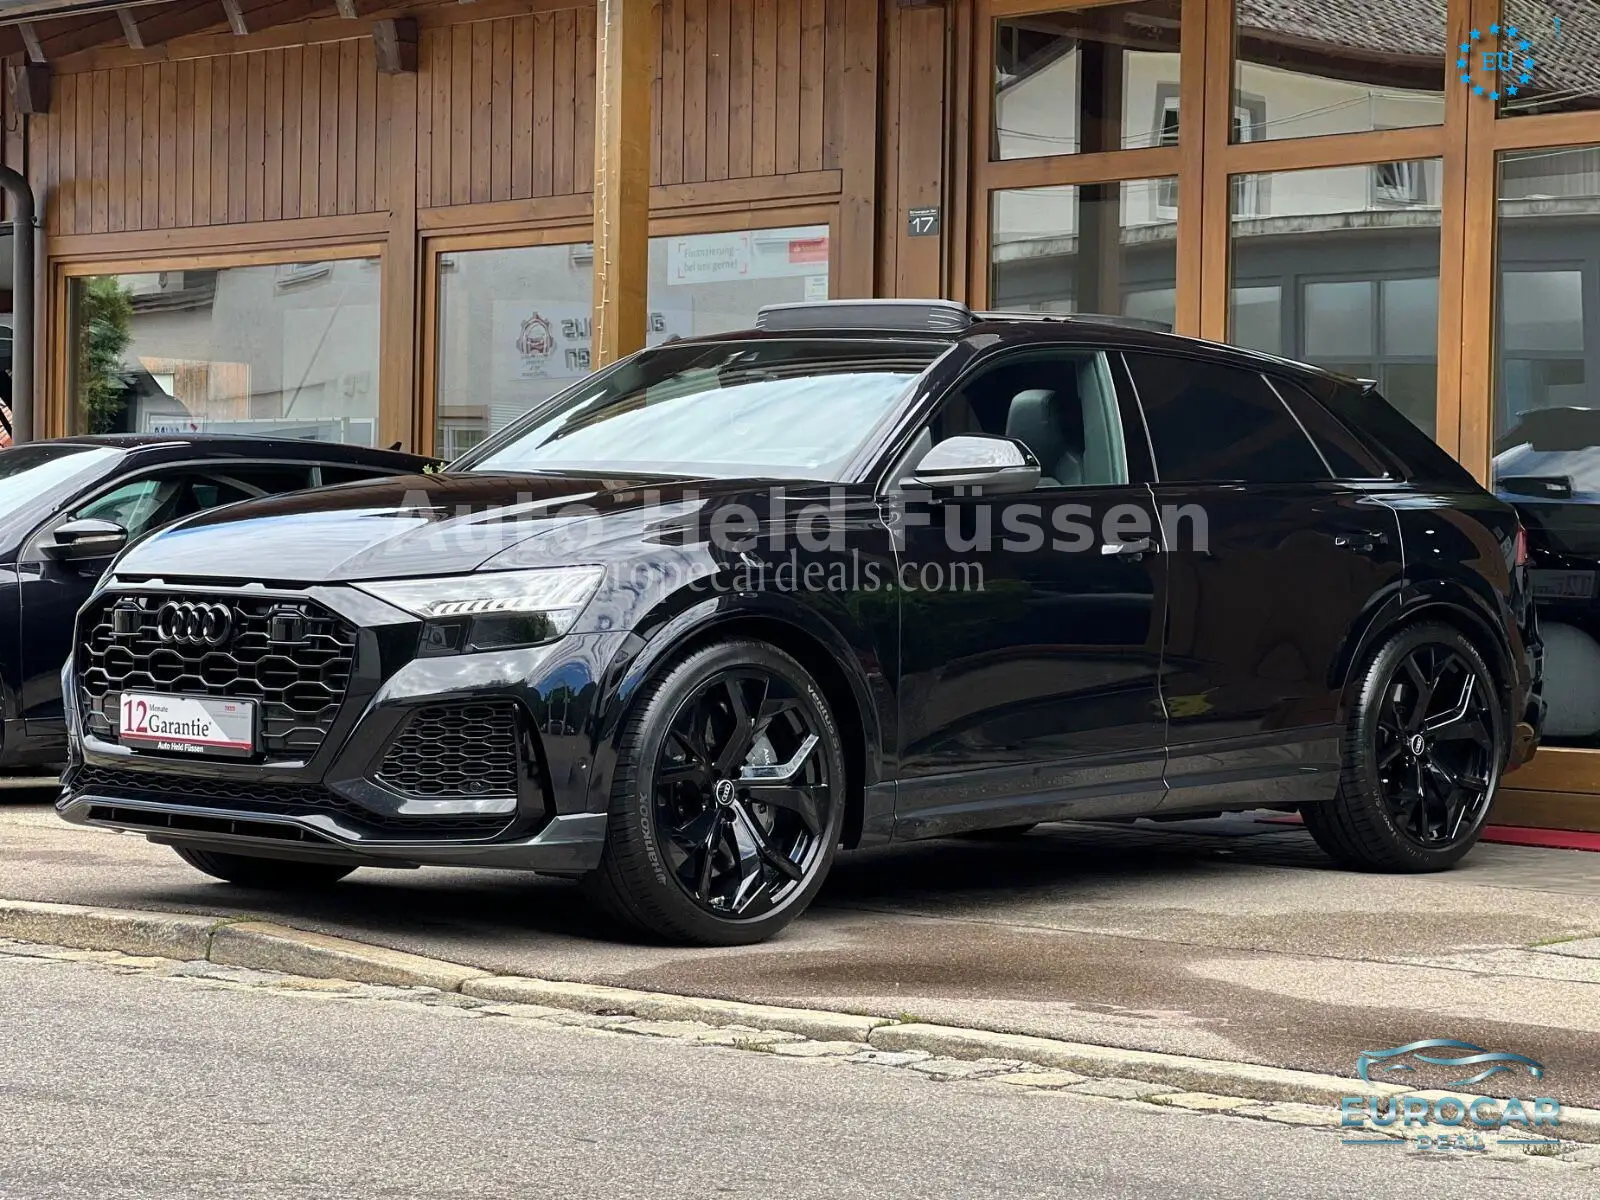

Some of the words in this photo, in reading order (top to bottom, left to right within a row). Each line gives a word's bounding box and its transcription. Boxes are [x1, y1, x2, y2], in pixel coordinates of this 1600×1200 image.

[912, 216, 934, 233] 17
[124, 699, 148, 734] 12
[149, 703, 169, 713] Monate
[158, 741, 170, 750] Auto
